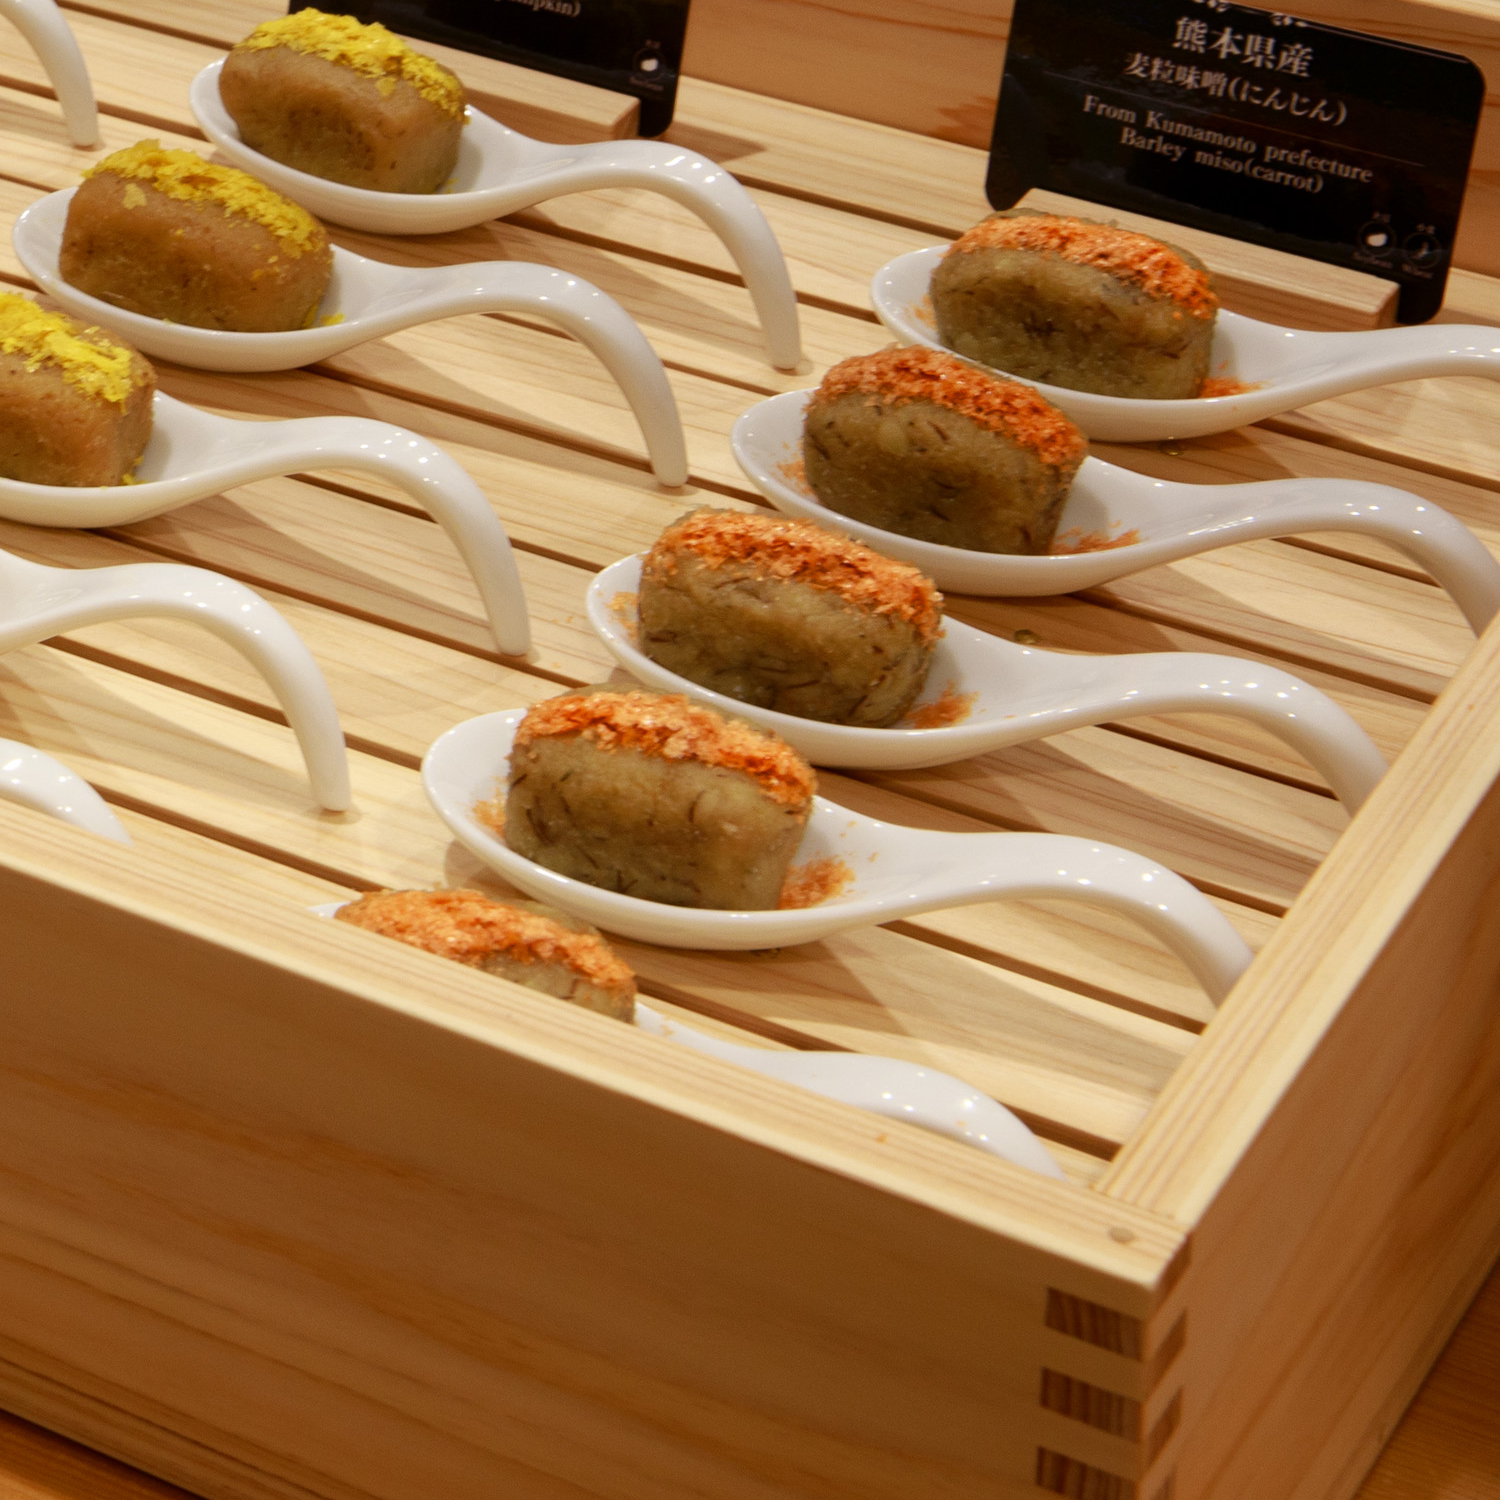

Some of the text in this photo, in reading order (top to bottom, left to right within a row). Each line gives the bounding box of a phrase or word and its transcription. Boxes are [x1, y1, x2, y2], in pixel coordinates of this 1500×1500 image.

[1172, 17, 1315, 79] 熊本県産
[1122, 53, 1349, 128] 麦粒味噌(にんじん)
[1083, 94, 1374, 183] From Kumamoto prefecture
[1120, 126, 1325, 195] Barley miso(carrot)
